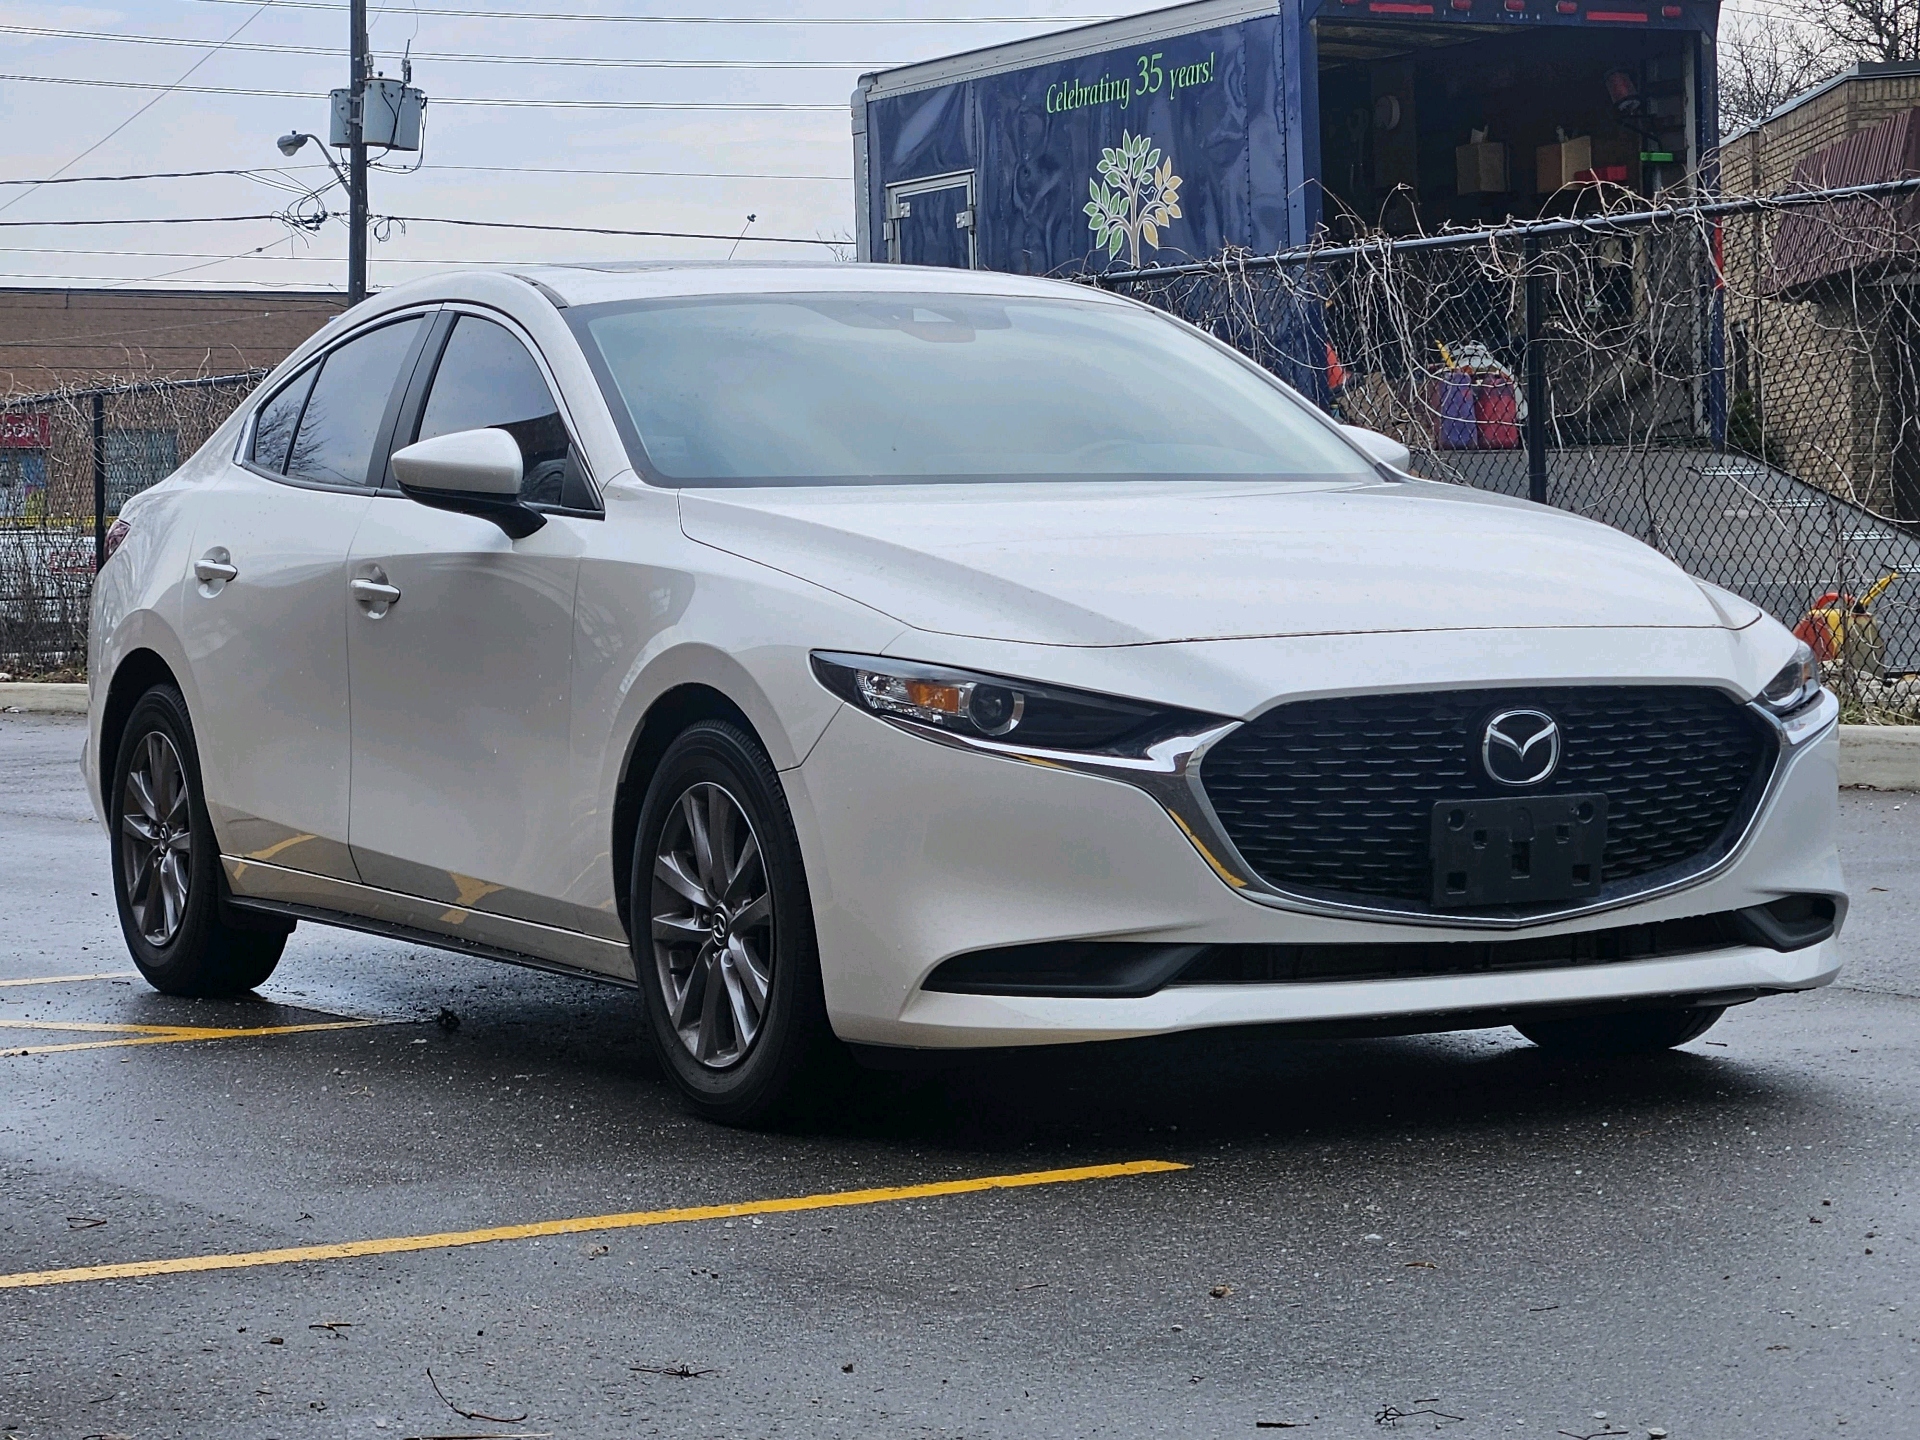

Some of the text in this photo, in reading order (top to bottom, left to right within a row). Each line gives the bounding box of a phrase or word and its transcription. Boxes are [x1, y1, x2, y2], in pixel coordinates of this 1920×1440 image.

[1046, 51, 1215, 113] Celebrating 35 years!
